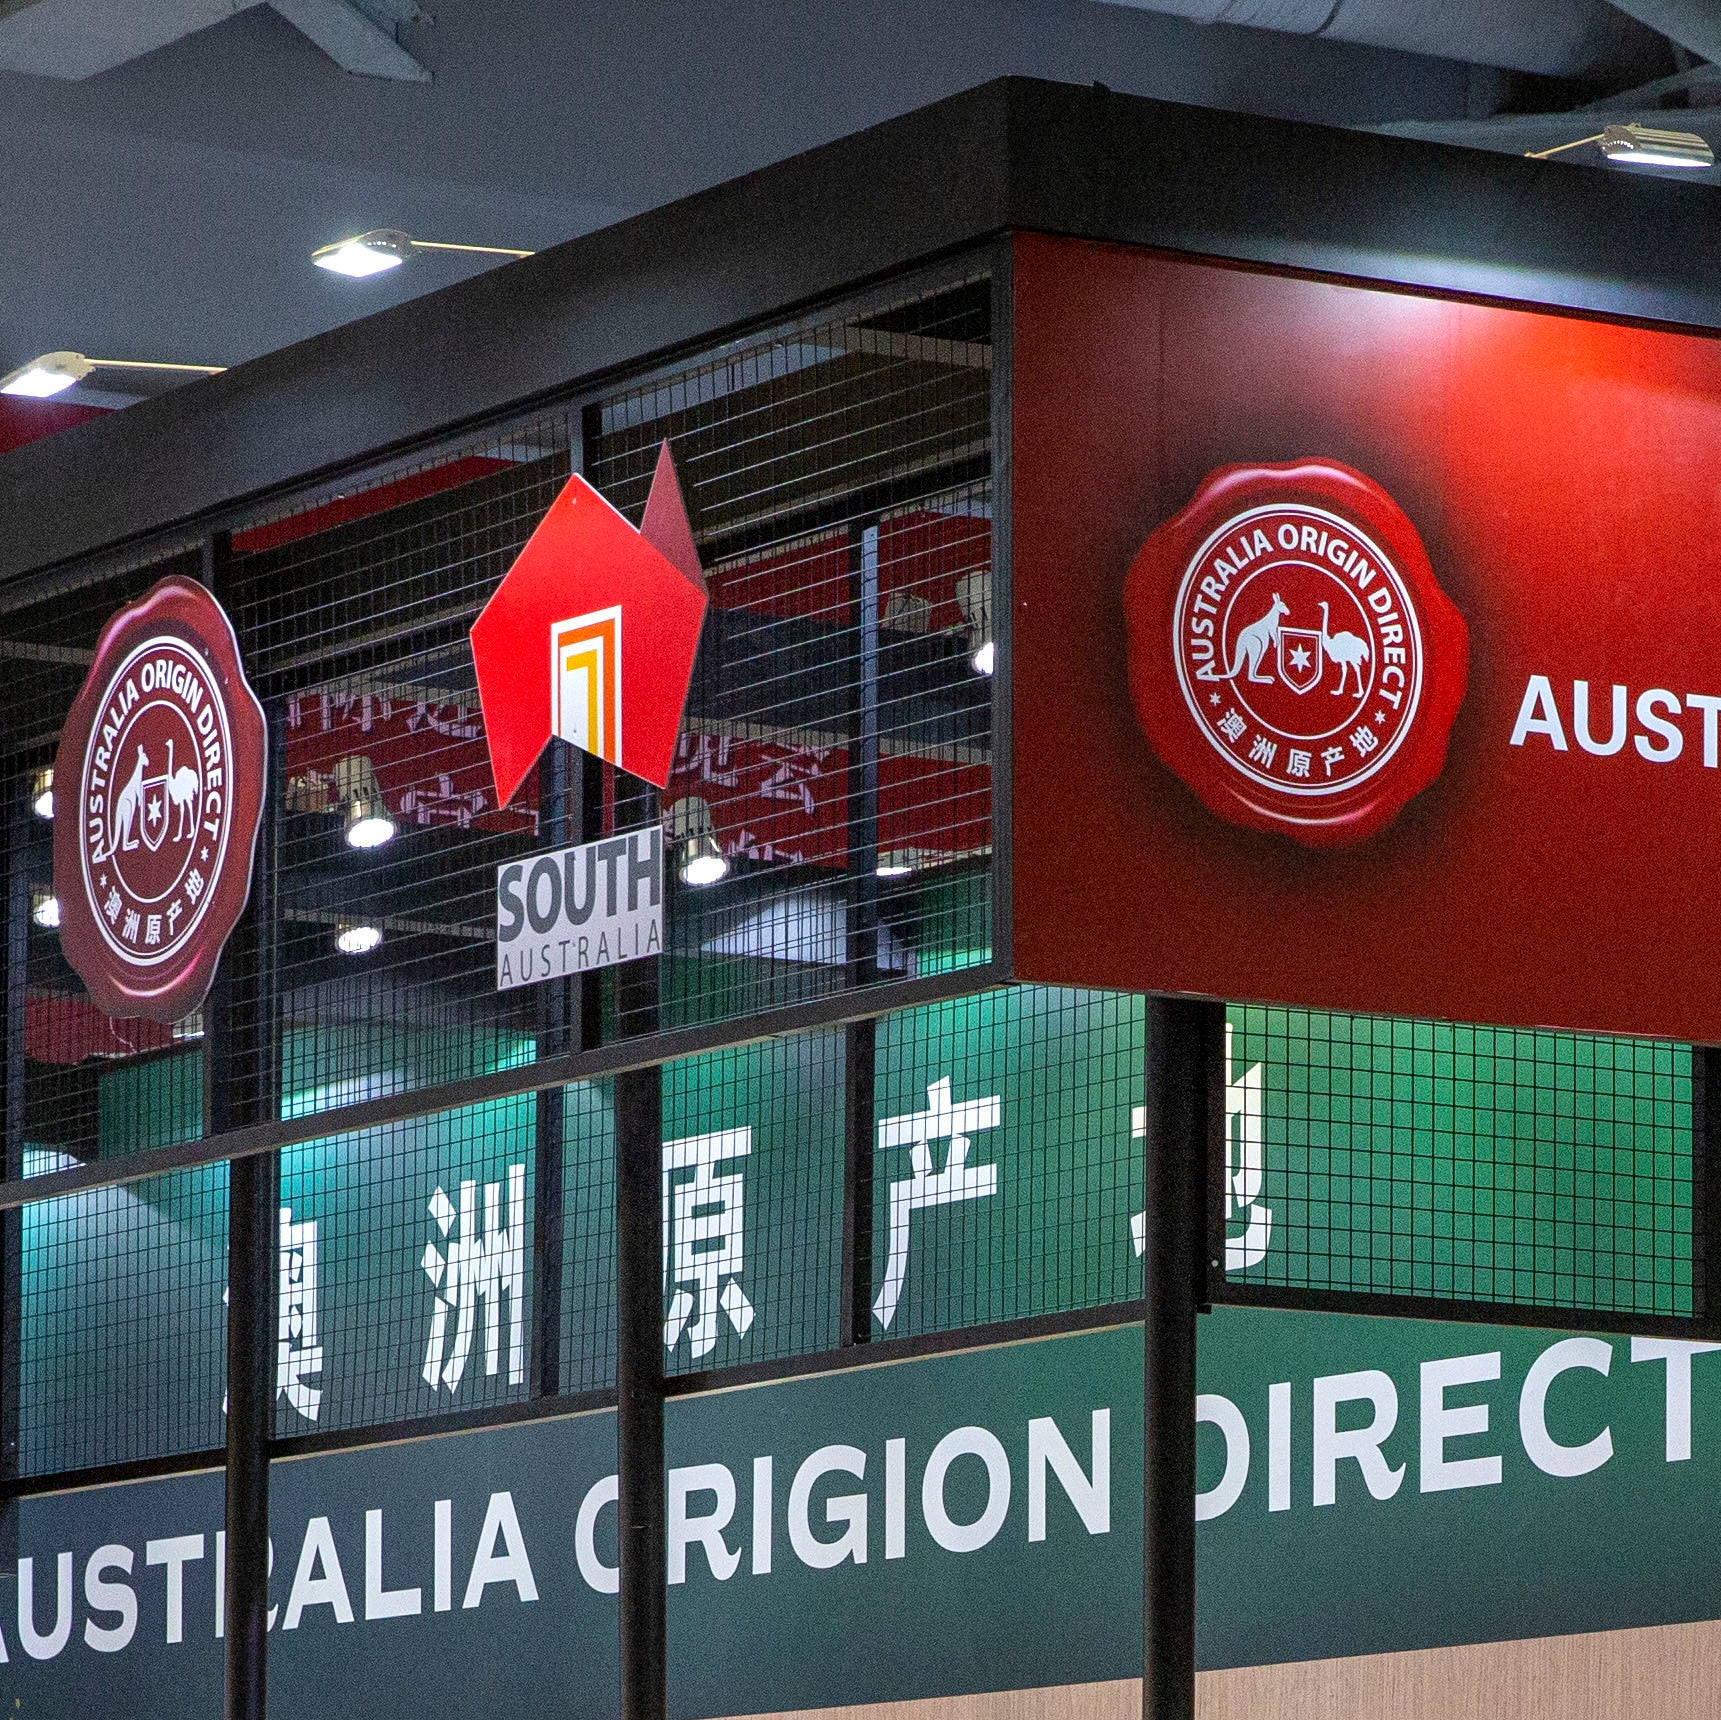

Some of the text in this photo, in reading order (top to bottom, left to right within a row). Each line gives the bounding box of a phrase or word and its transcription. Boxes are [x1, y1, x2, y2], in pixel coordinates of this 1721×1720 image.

[1191, 523, 1407, 710] AUSTRALIA ORIGIN DIRECT
[90, 677, 140, 865] AUSTRALIA
[141, 658, 204, 714] ORIGIN
[195, 706, 224, 842] DIRECT
[1216, 706, 1380, 777] 澳洲原产地
[498, 830, 663, 944] SOUTH
[500, 923, 662, 986] AUSTRALIA
